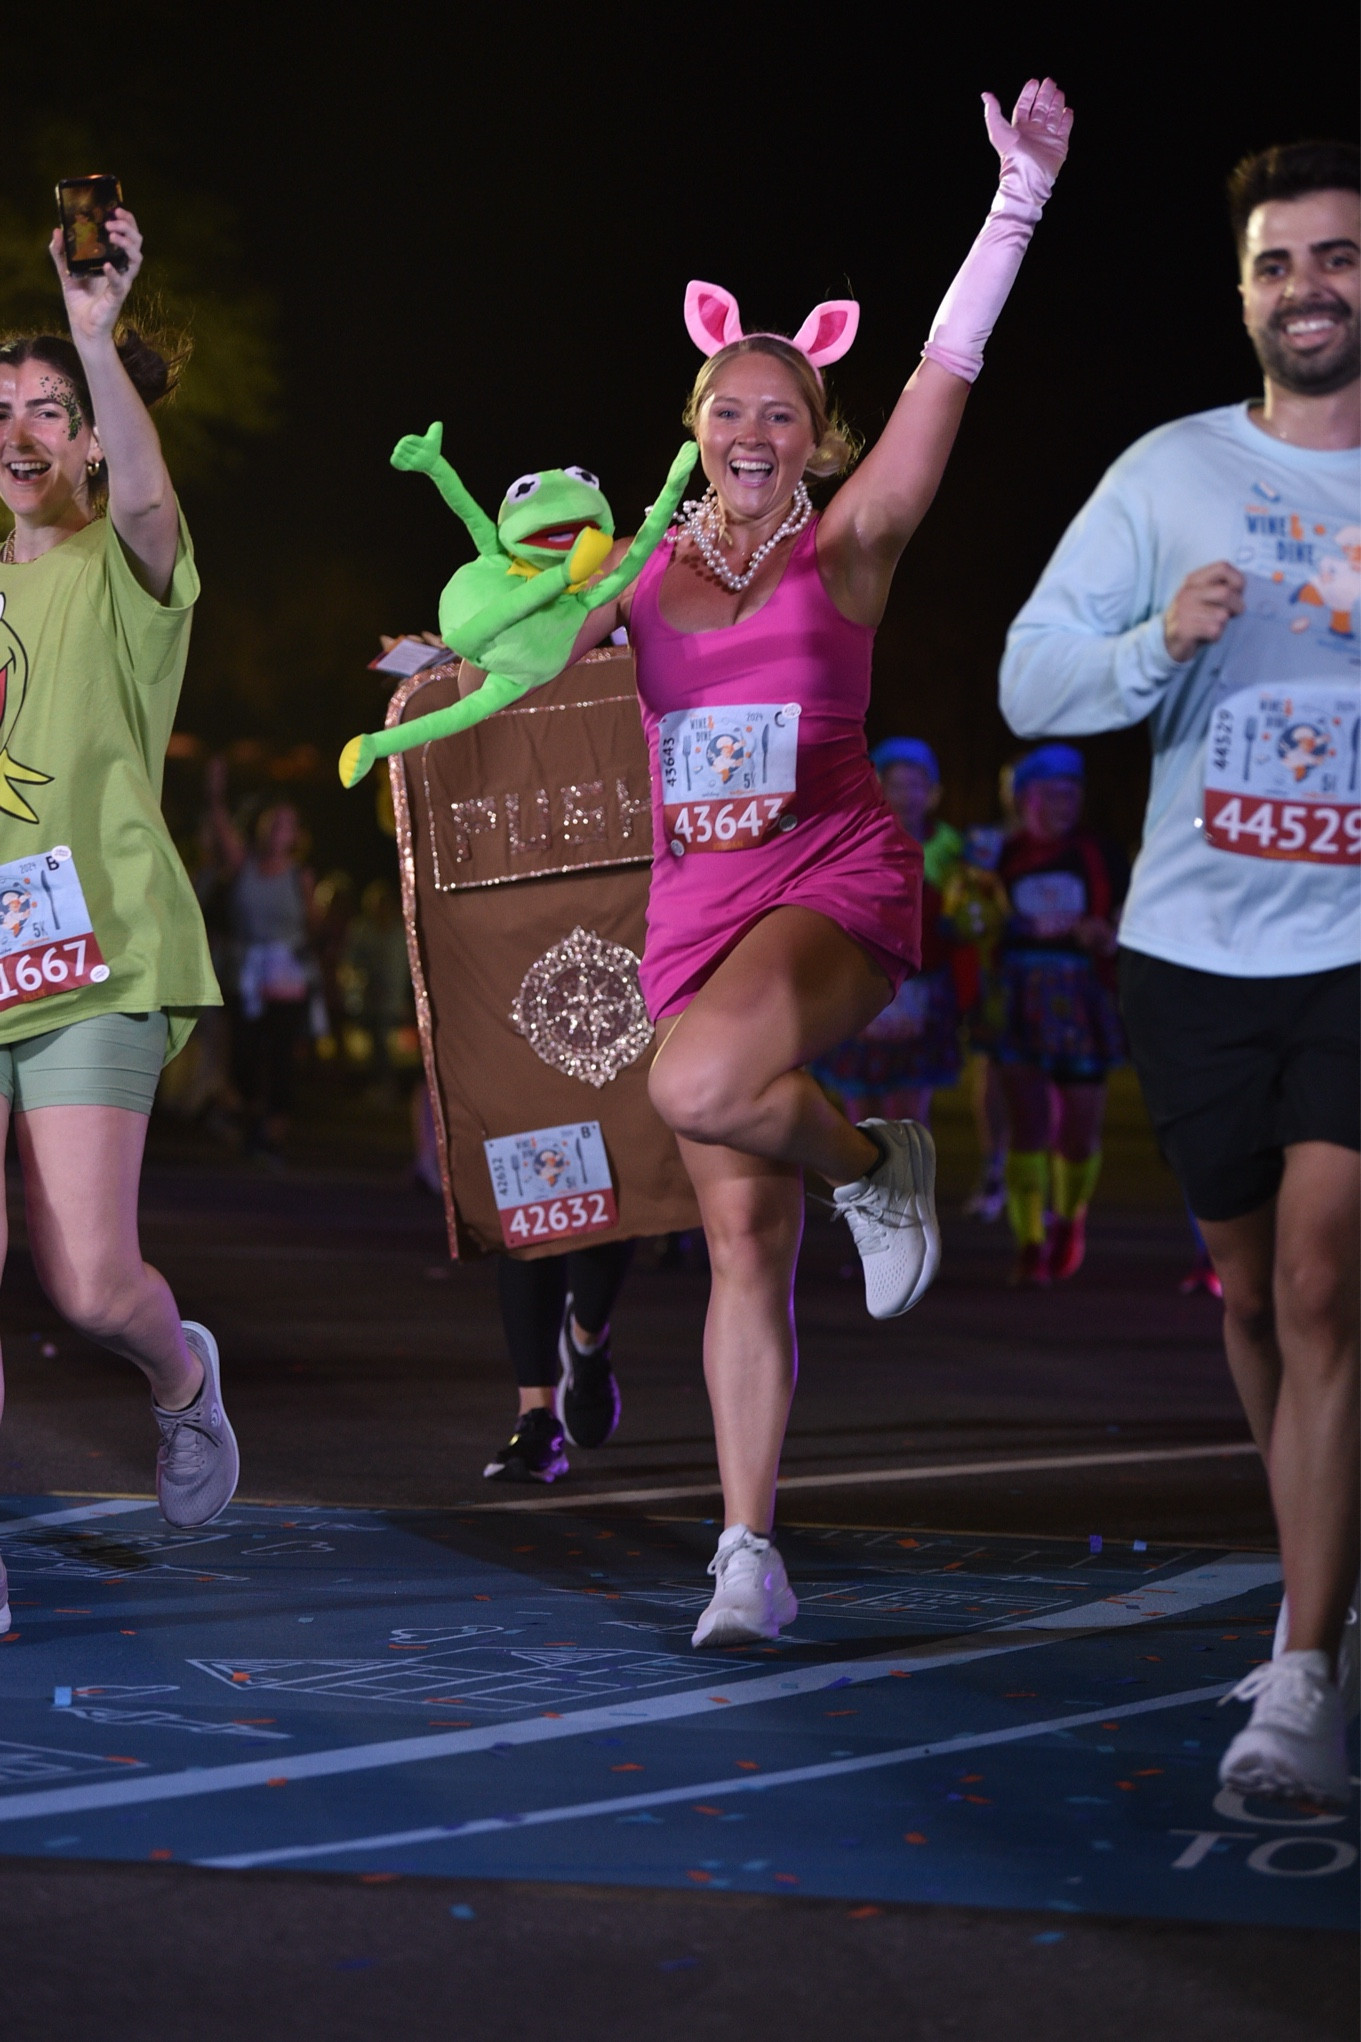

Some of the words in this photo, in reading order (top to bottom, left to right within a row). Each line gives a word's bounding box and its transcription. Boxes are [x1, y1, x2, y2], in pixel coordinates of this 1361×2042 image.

[1245, 514, 1286, 537] WINE
[1276, 540, 1314, 565] DINE
[690, 716, 707, 730] WINE
[746, 712, 764, 722] 2024
[696, 731, 712, 743] DINE
[1213, 709, 1234, 770] 44529
[663, 737, 677, 787] 43643
[1213, 798, 1361, 855] 44529
[19, 862, 37, 874] 2024
[45, 855, 60, 871] B
[32, 920, 49, 938] 5K
[0, 939, 87, 1000] 1667
[581, 1125, 591, 1139] B
[510, 1194, 609, 1238] 42632
